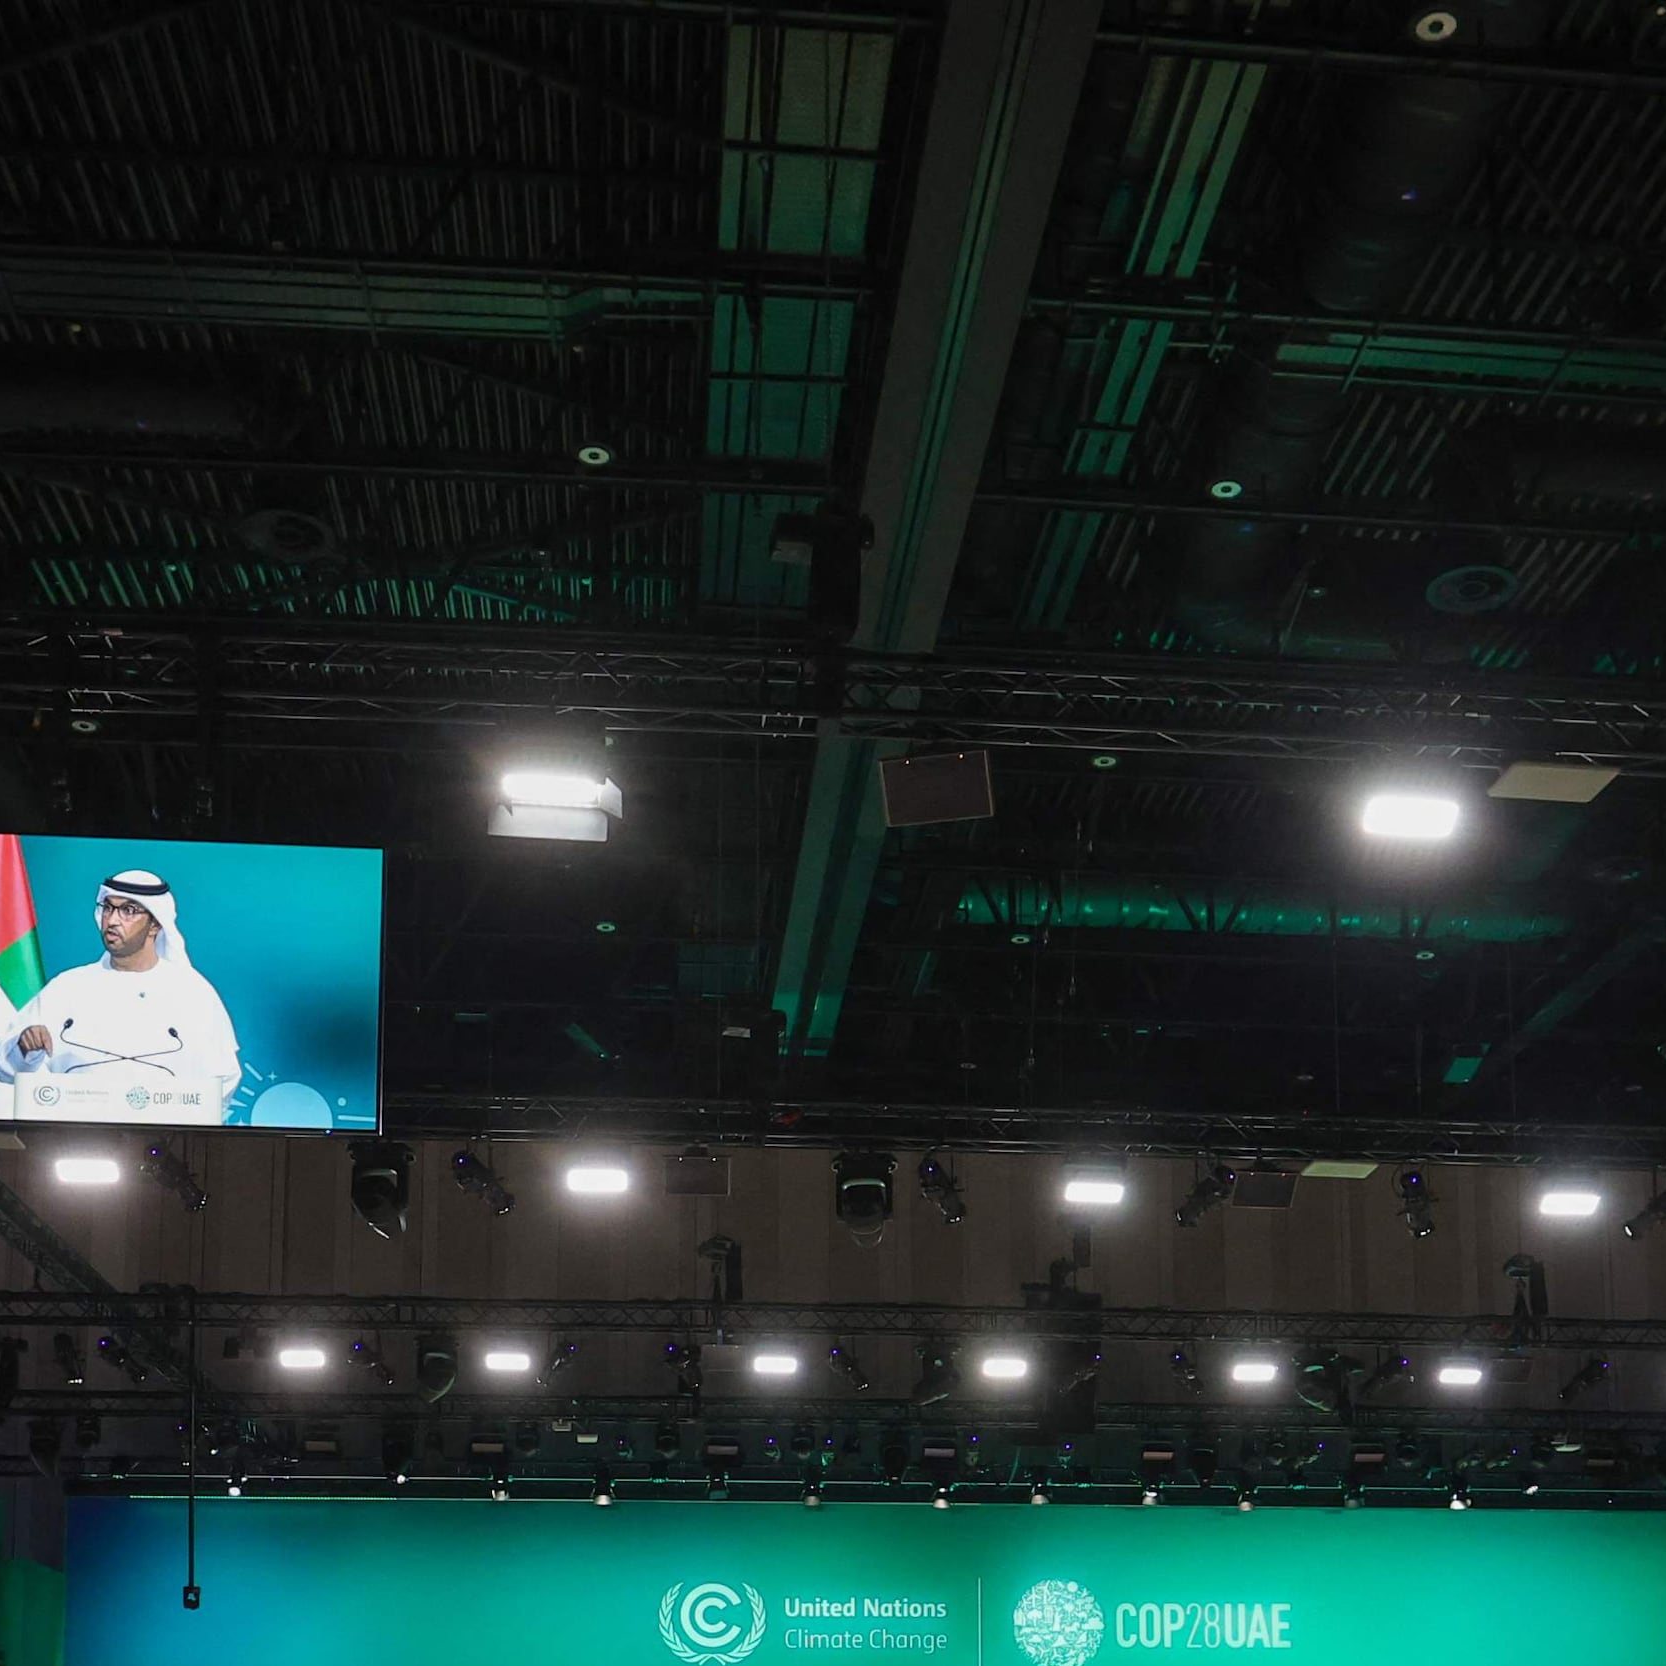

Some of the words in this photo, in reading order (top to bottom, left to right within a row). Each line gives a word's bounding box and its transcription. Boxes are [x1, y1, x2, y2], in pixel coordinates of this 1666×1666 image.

[153, 1092, 201, 1105] COPUAE
[784, 1597, 856, 1618] United
[863, 1597, 947, 1618] Nations
[1115, 1603, 1292, 1649] COP28UAE
[784, 1628, 864, 1650] Climate
[868, 1628, 948, 1655] Change
